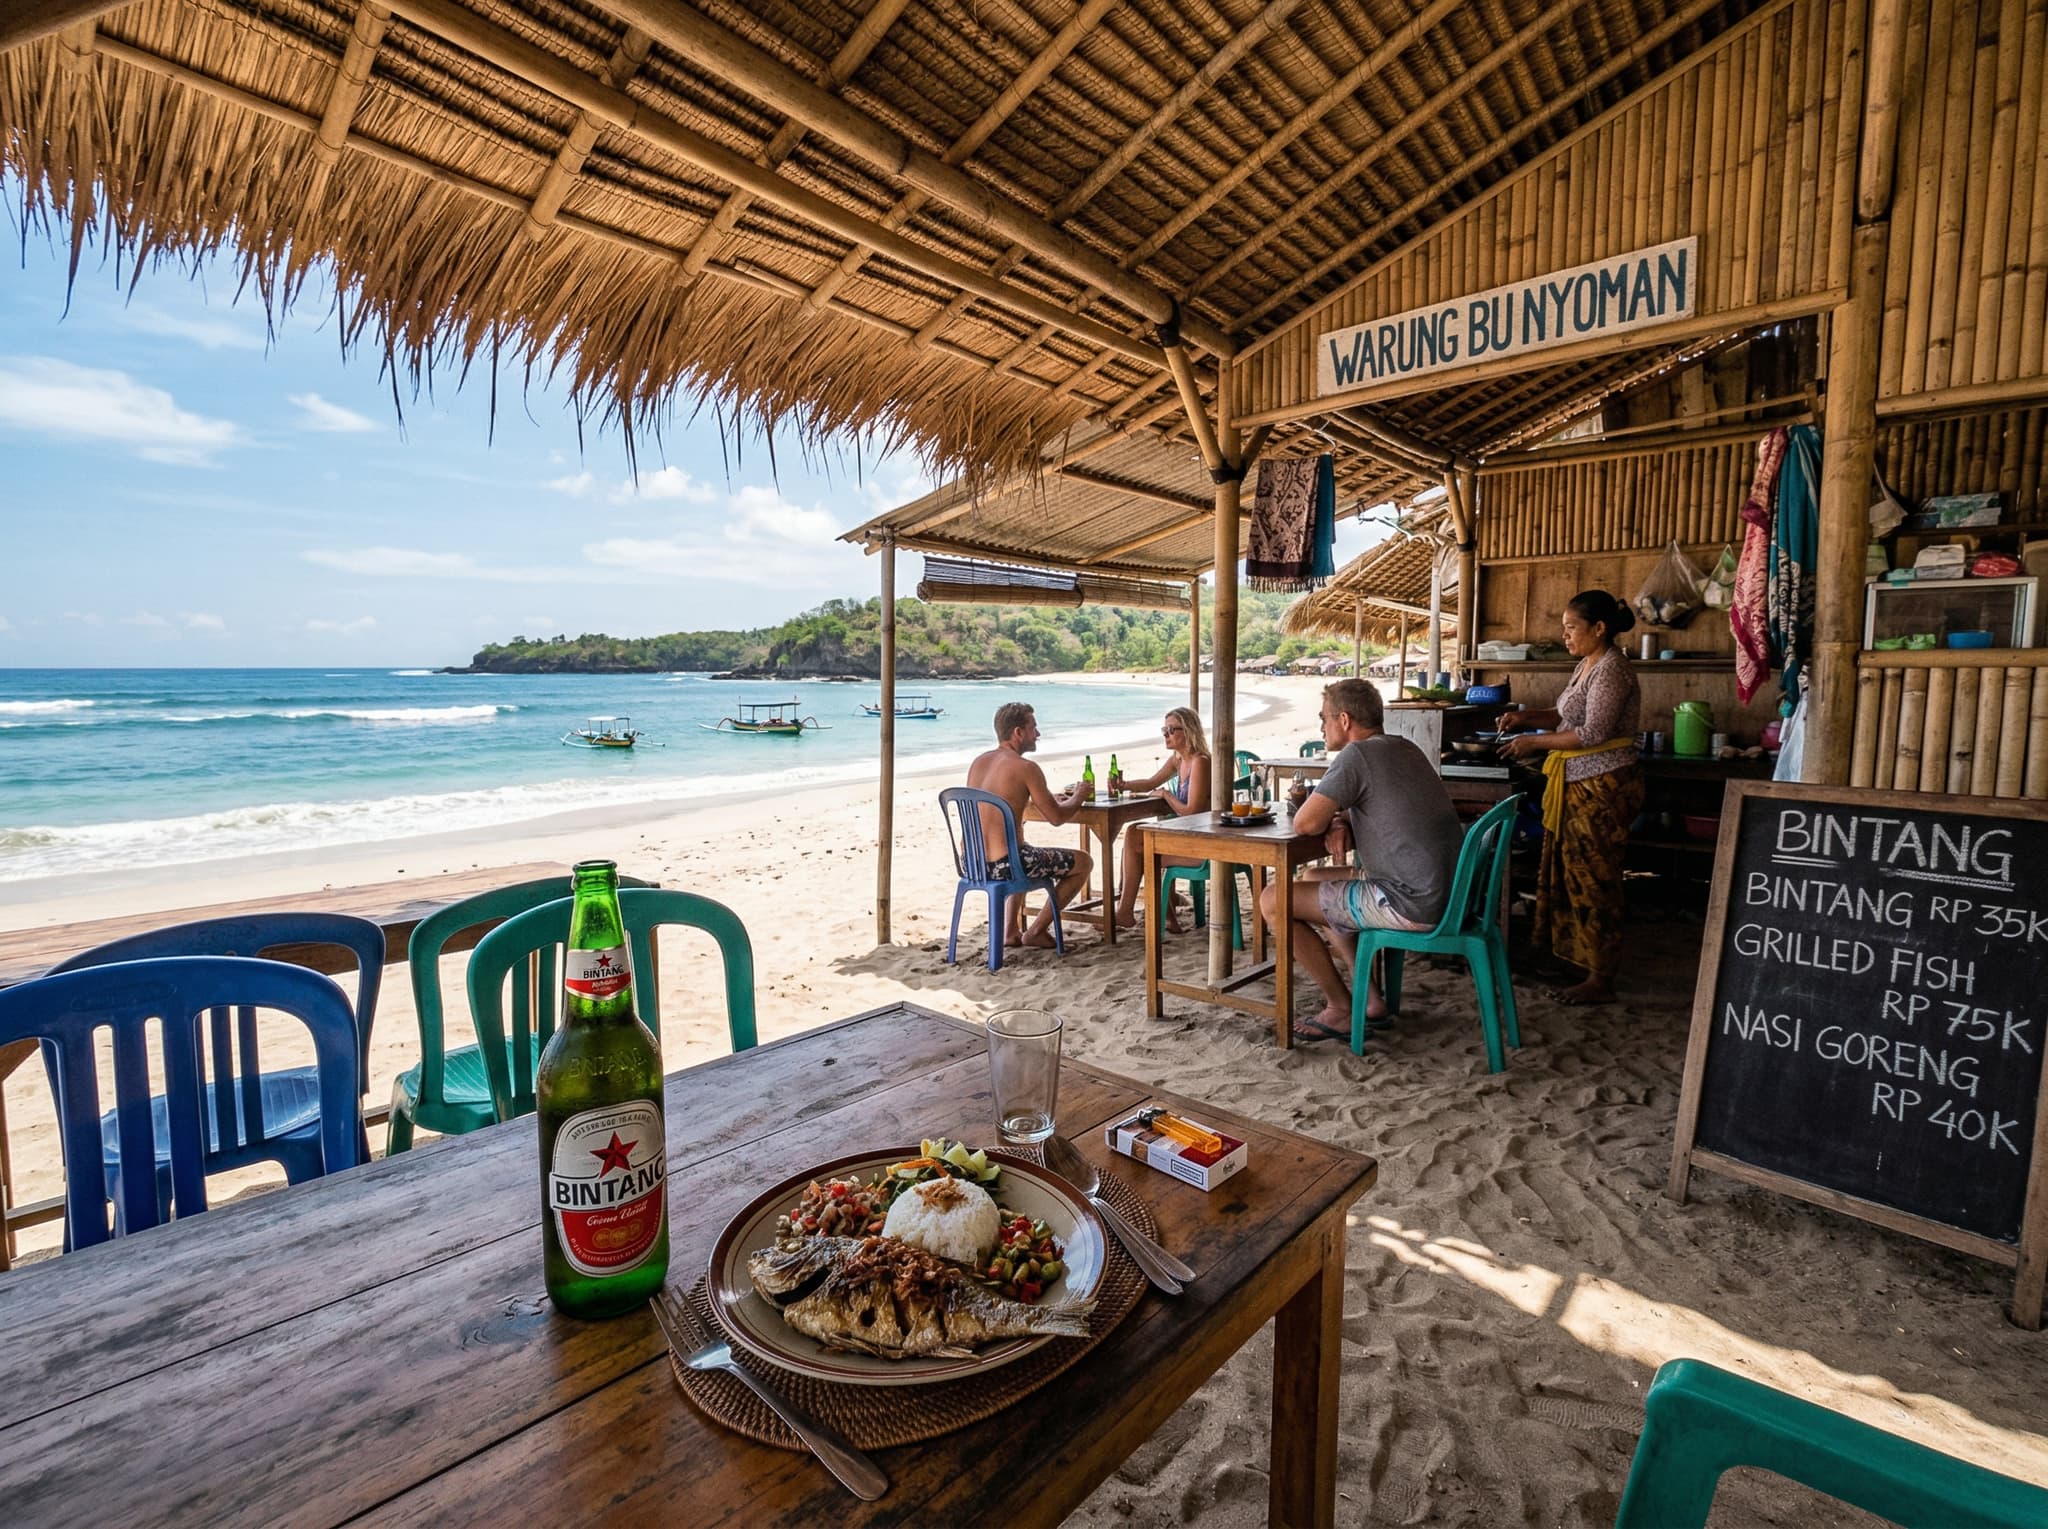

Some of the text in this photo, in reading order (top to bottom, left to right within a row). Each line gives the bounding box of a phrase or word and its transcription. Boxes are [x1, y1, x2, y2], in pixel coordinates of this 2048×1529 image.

[1329, 248, 1688, 387] WARUNG BU NYOMAN
[1775, 810, 2014, 881] BINTANG
[1745, 872, 2048, 943] BINTANG RP 35K
[583, 965, 625, 979] BINTANG
[1734, 923, 1975, 995] GRILLED FISH
[1723, 1002, 1980, 1098] NASI GORENG
[1881, 989, 2033, 1054] RP 75K
[1872, 1082, 2019, 1156] RP 40K
